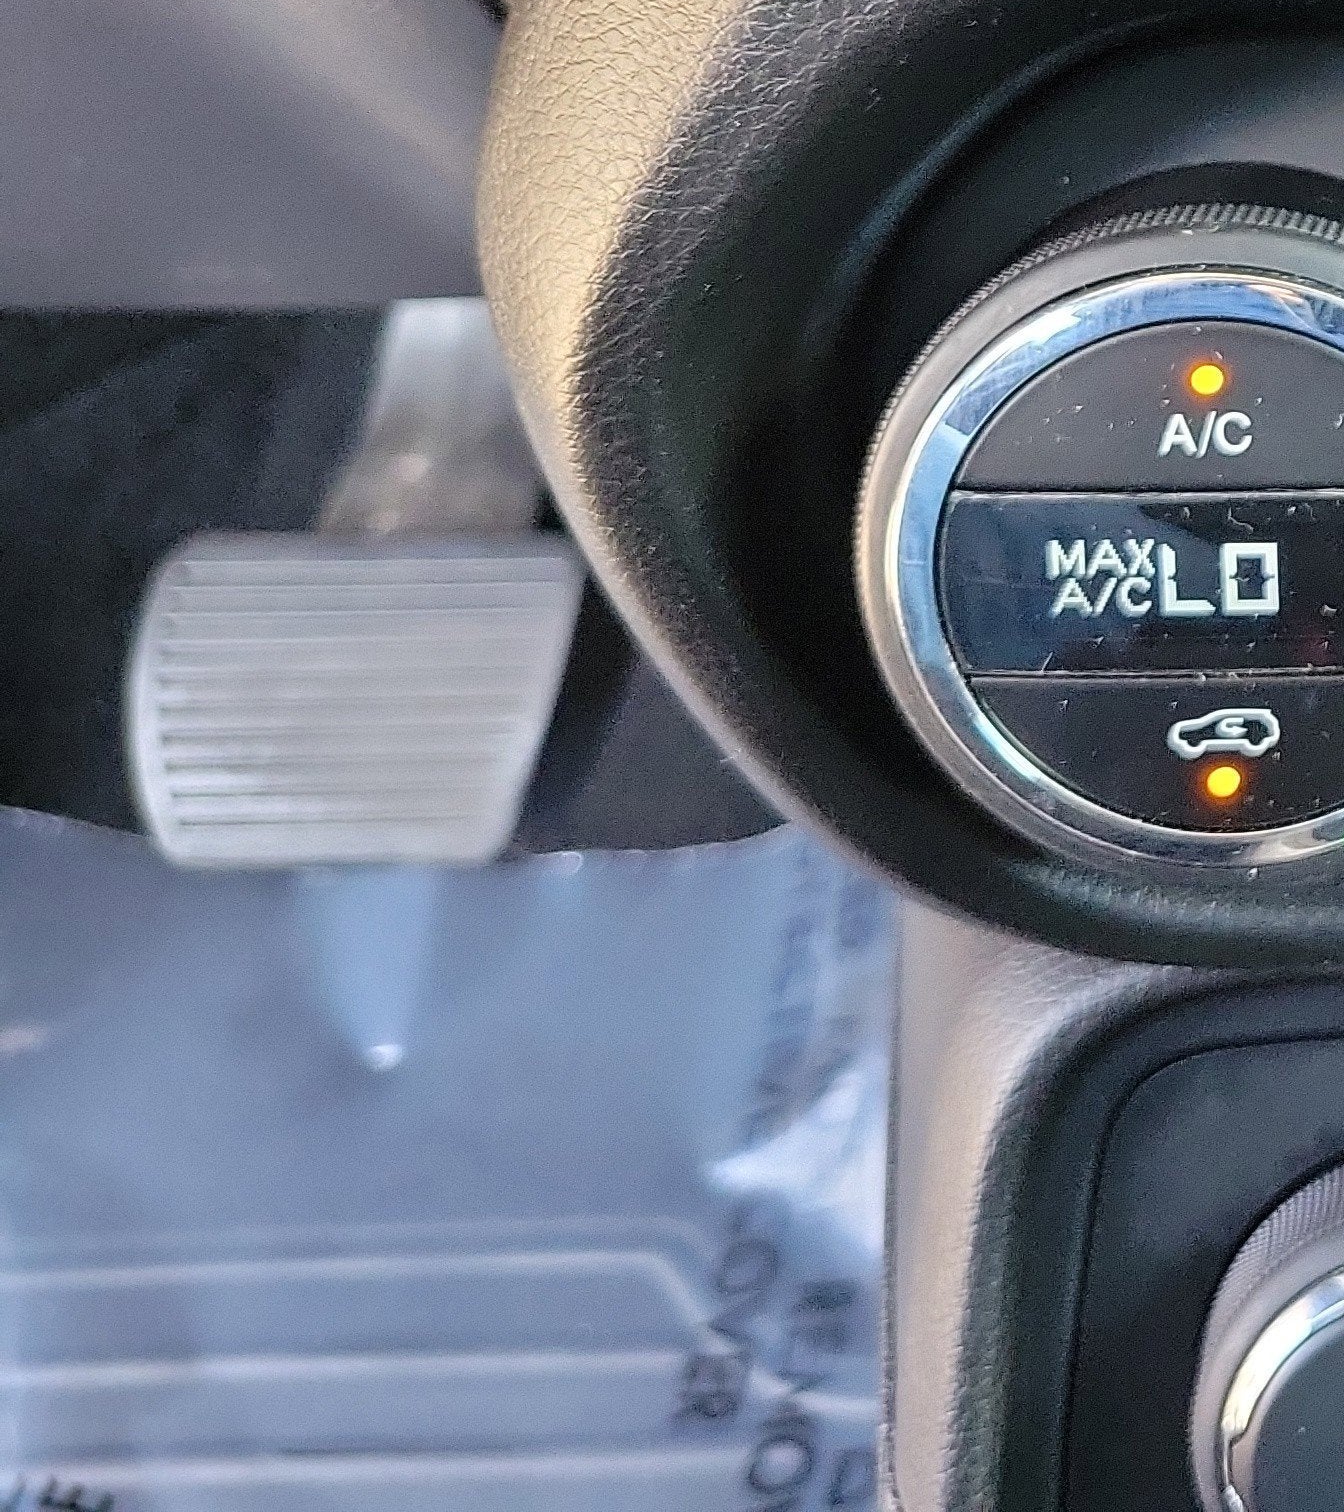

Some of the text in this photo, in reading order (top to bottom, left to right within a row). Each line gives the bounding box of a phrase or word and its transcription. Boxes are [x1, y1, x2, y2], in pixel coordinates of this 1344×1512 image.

[1157, 410, 1253, 457] A/C
[1044, 538, 1156, 578] MAX
[1051, 576, 1153, 618] A/C
